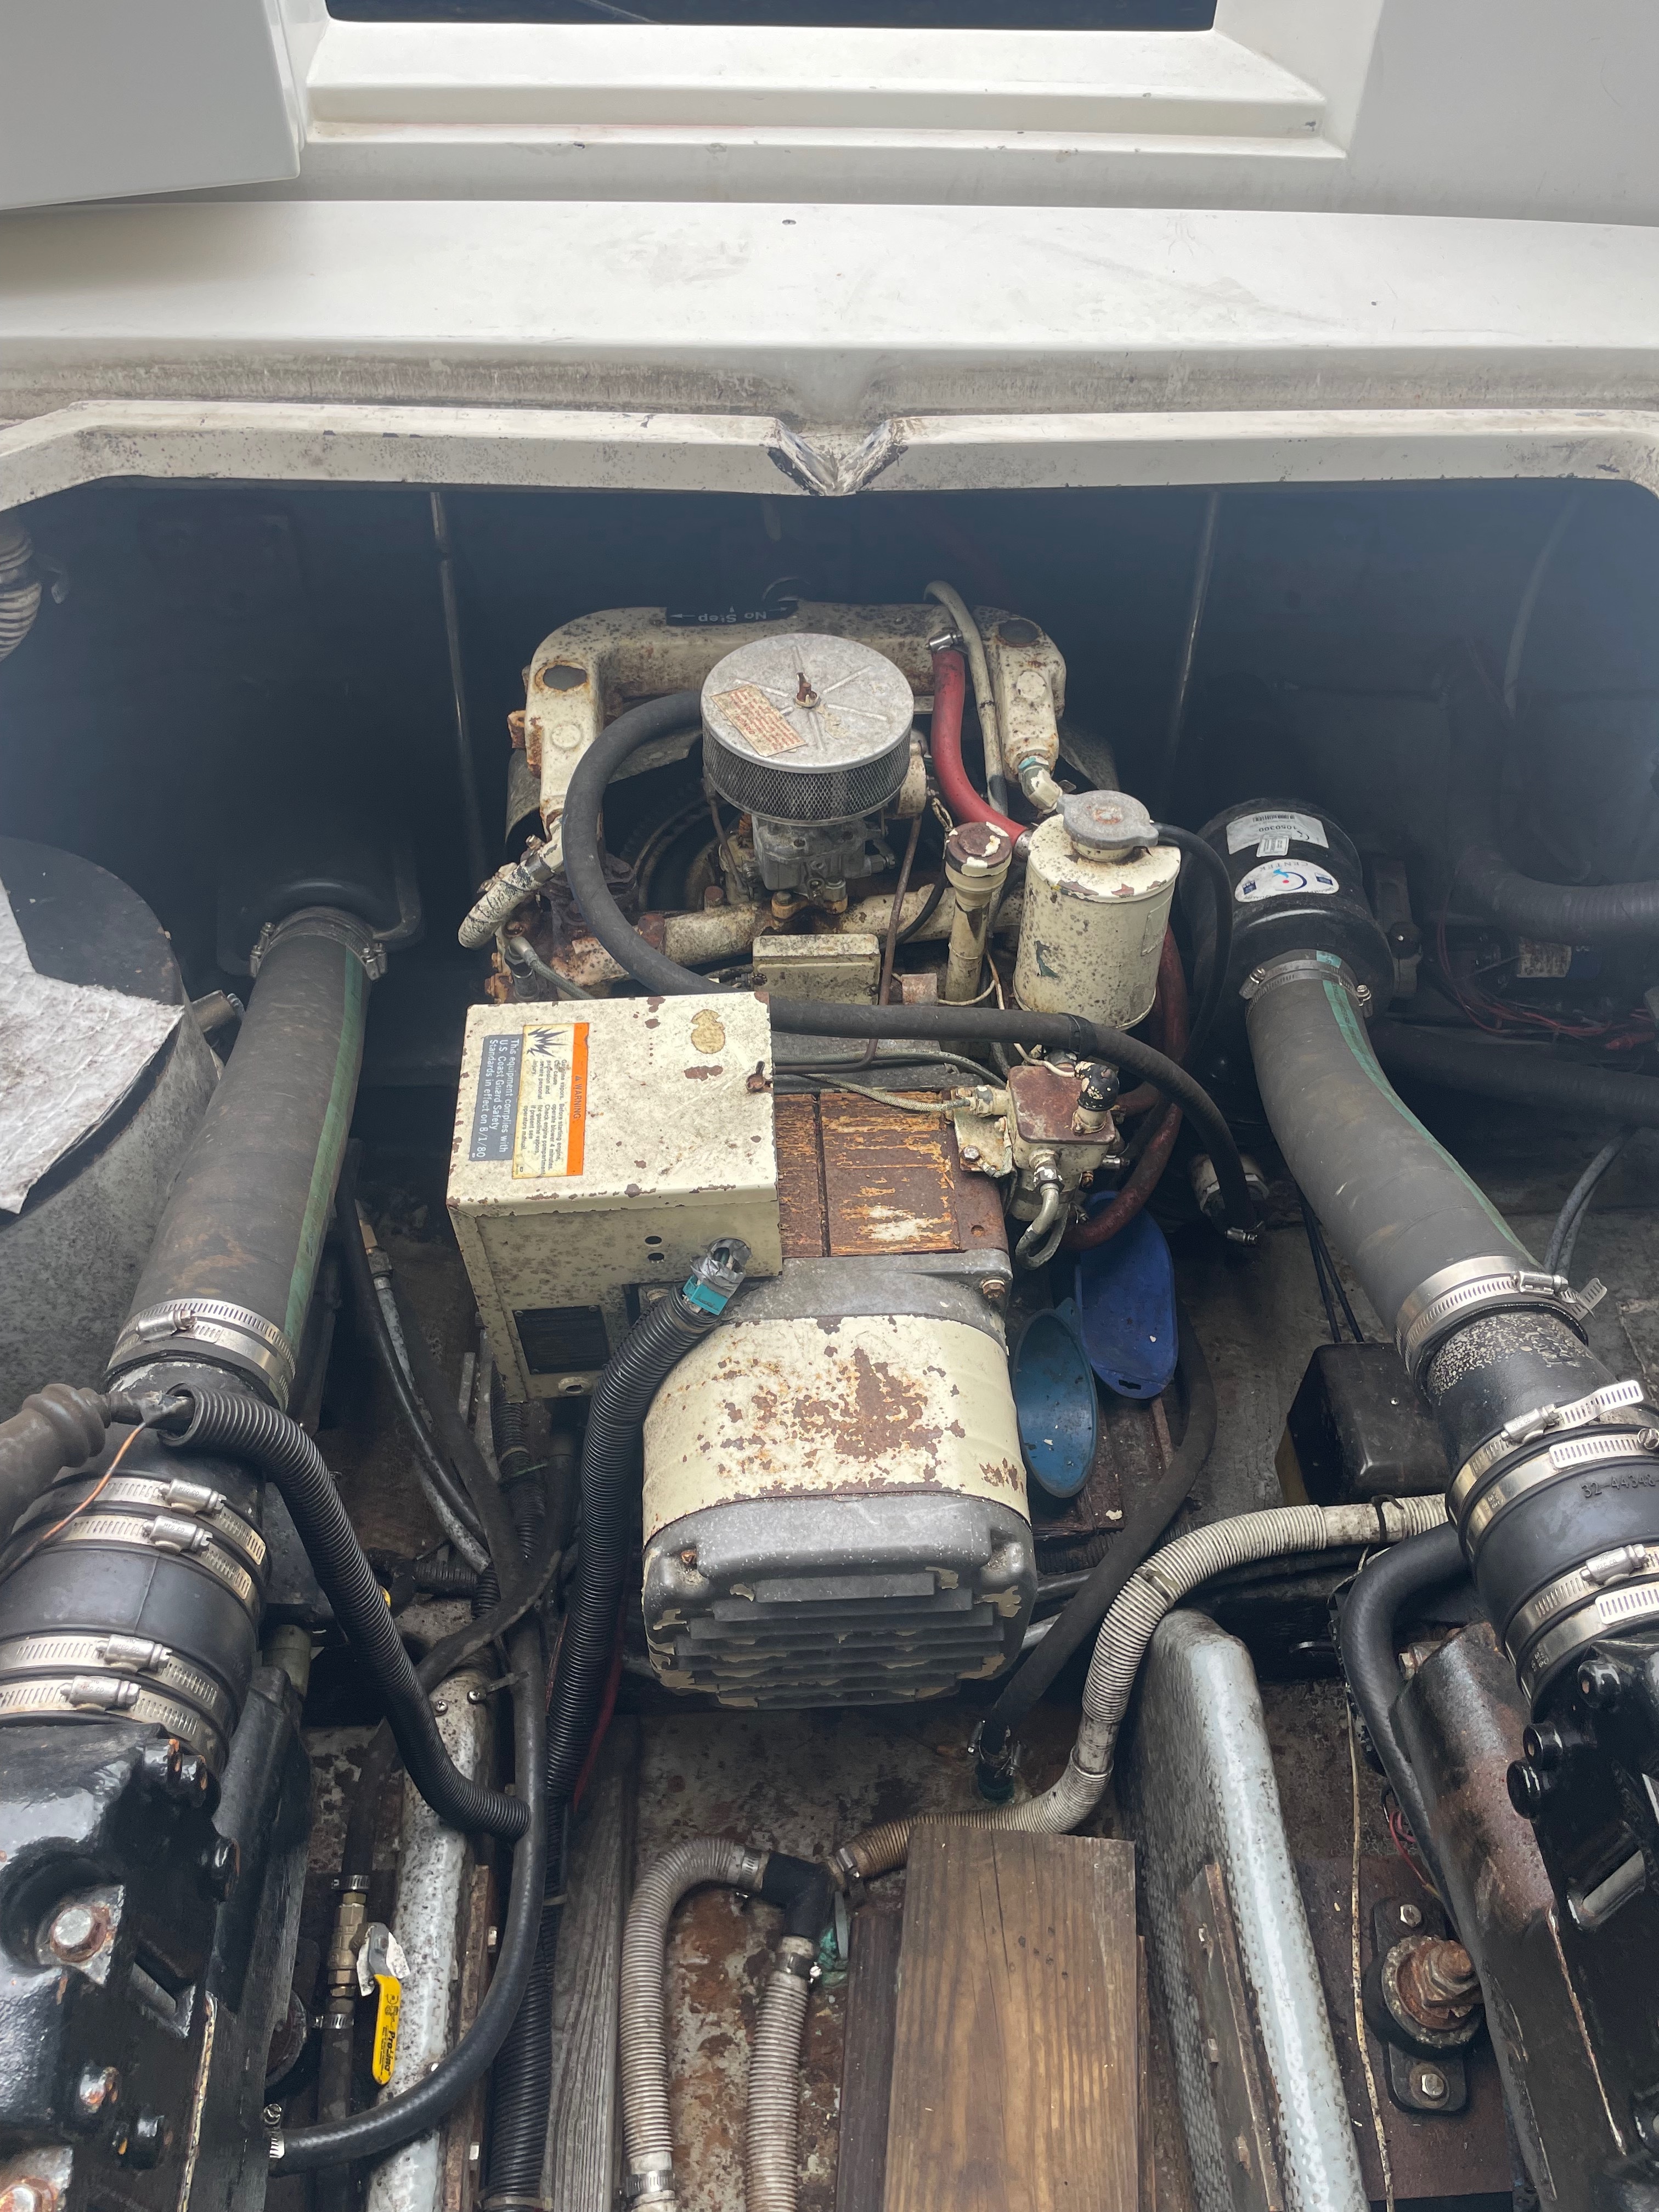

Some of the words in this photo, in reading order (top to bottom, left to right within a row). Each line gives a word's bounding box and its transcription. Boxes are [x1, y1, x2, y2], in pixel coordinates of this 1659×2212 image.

[698, 613, 737, 623] Step
[744, 611, 766, 620] No
[1259, 862, 1308, 871] CENTEK
[498, 1040, 508, 1054] U.S.
[510, 1039, 520, 1054] This
[486, 1040, 498, 1077] Standards
[496, 1056, 506, 1077] Coast
[505, 1057, 516, 1097] equipment
[482, 1088, 493, 1112] effect
[494, 1080, 504, 1103] Guard
[573, 1084, 582, 1119] WARNING
[480, 1114, 488, 1124] on
[489, 1104, 502, 1130] Safety
[501, 1099, 512, 1133] complies
[476, 1127, 488, 1158] 8/1/80
[499, 1135, 509, 1153] with
